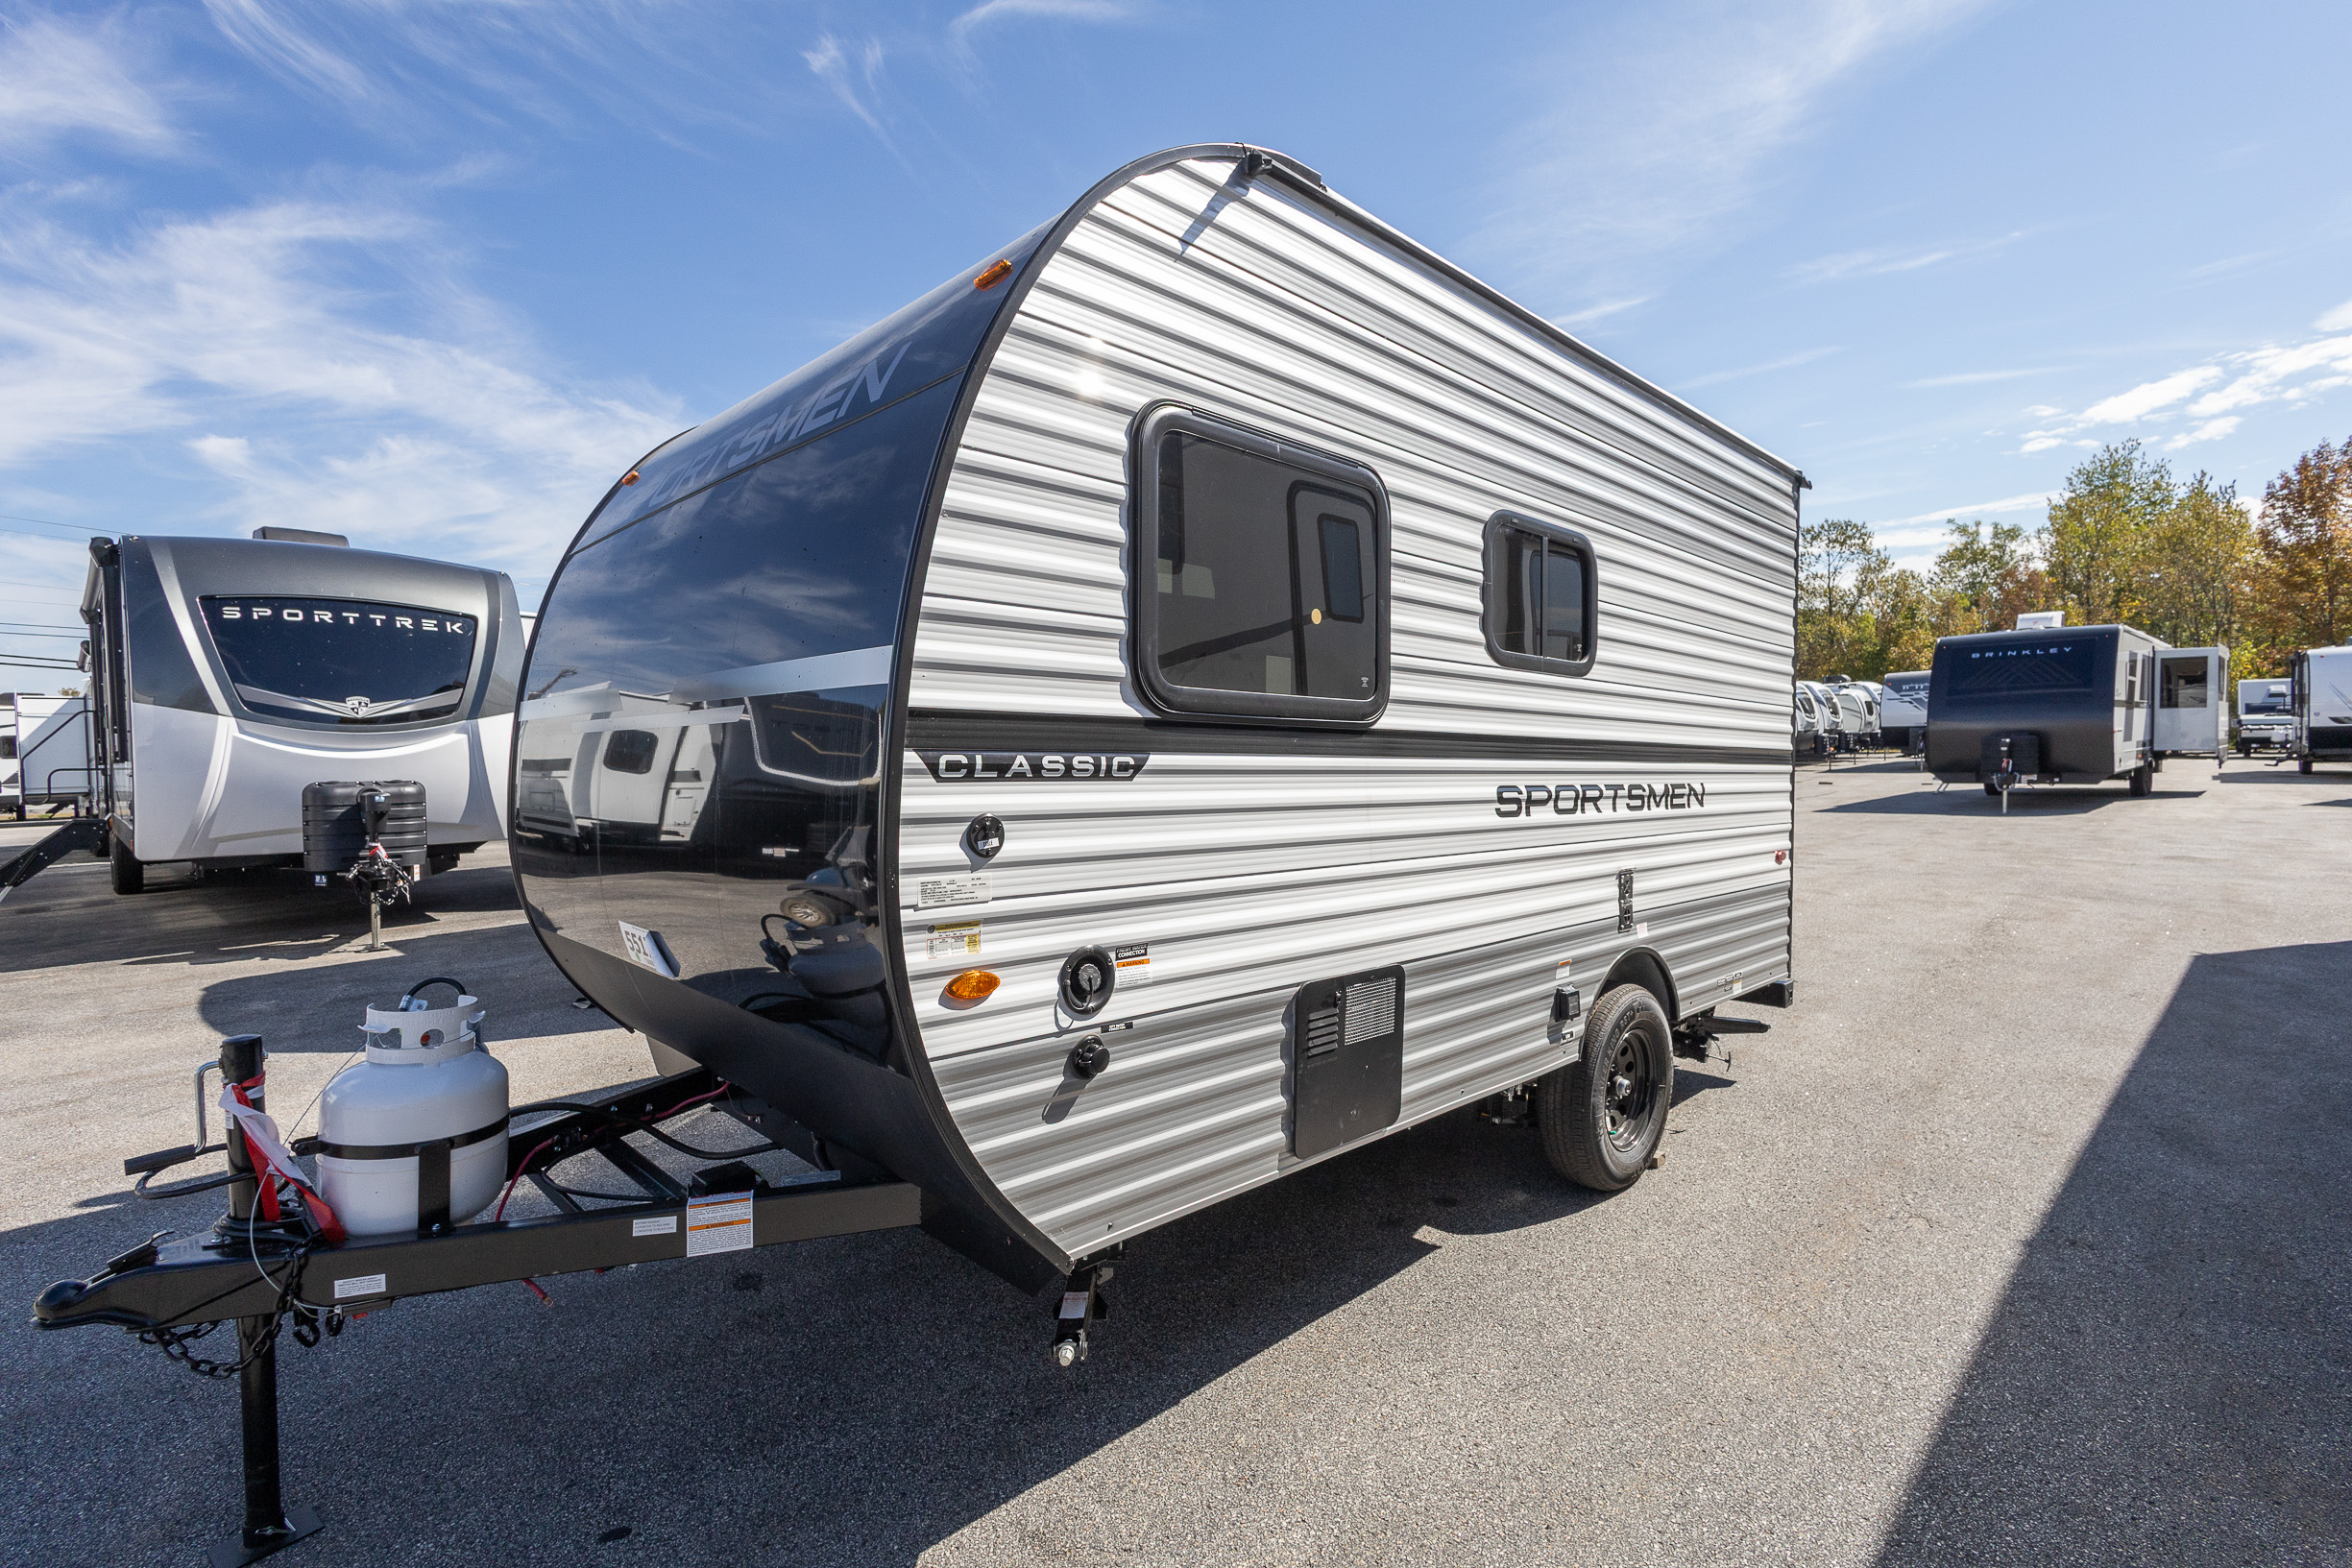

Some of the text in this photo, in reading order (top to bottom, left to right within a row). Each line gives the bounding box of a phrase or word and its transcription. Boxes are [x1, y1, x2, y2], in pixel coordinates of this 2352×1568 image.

[629, 341, 912, 514] ORTSMEN
[222, 606, 464, 635] SPORTTREK
[1971, 646, 2073, 659] BRINKLEY
[938, 754, 1135, 778] CLASSIC
[1494, 783, 1706, 818] SPORTSMEN
[624, 930, 652, 958] 551
[1117, 949, 1146, 958] CONNECTION
[1607, 1028, 1621, 1056] KING
